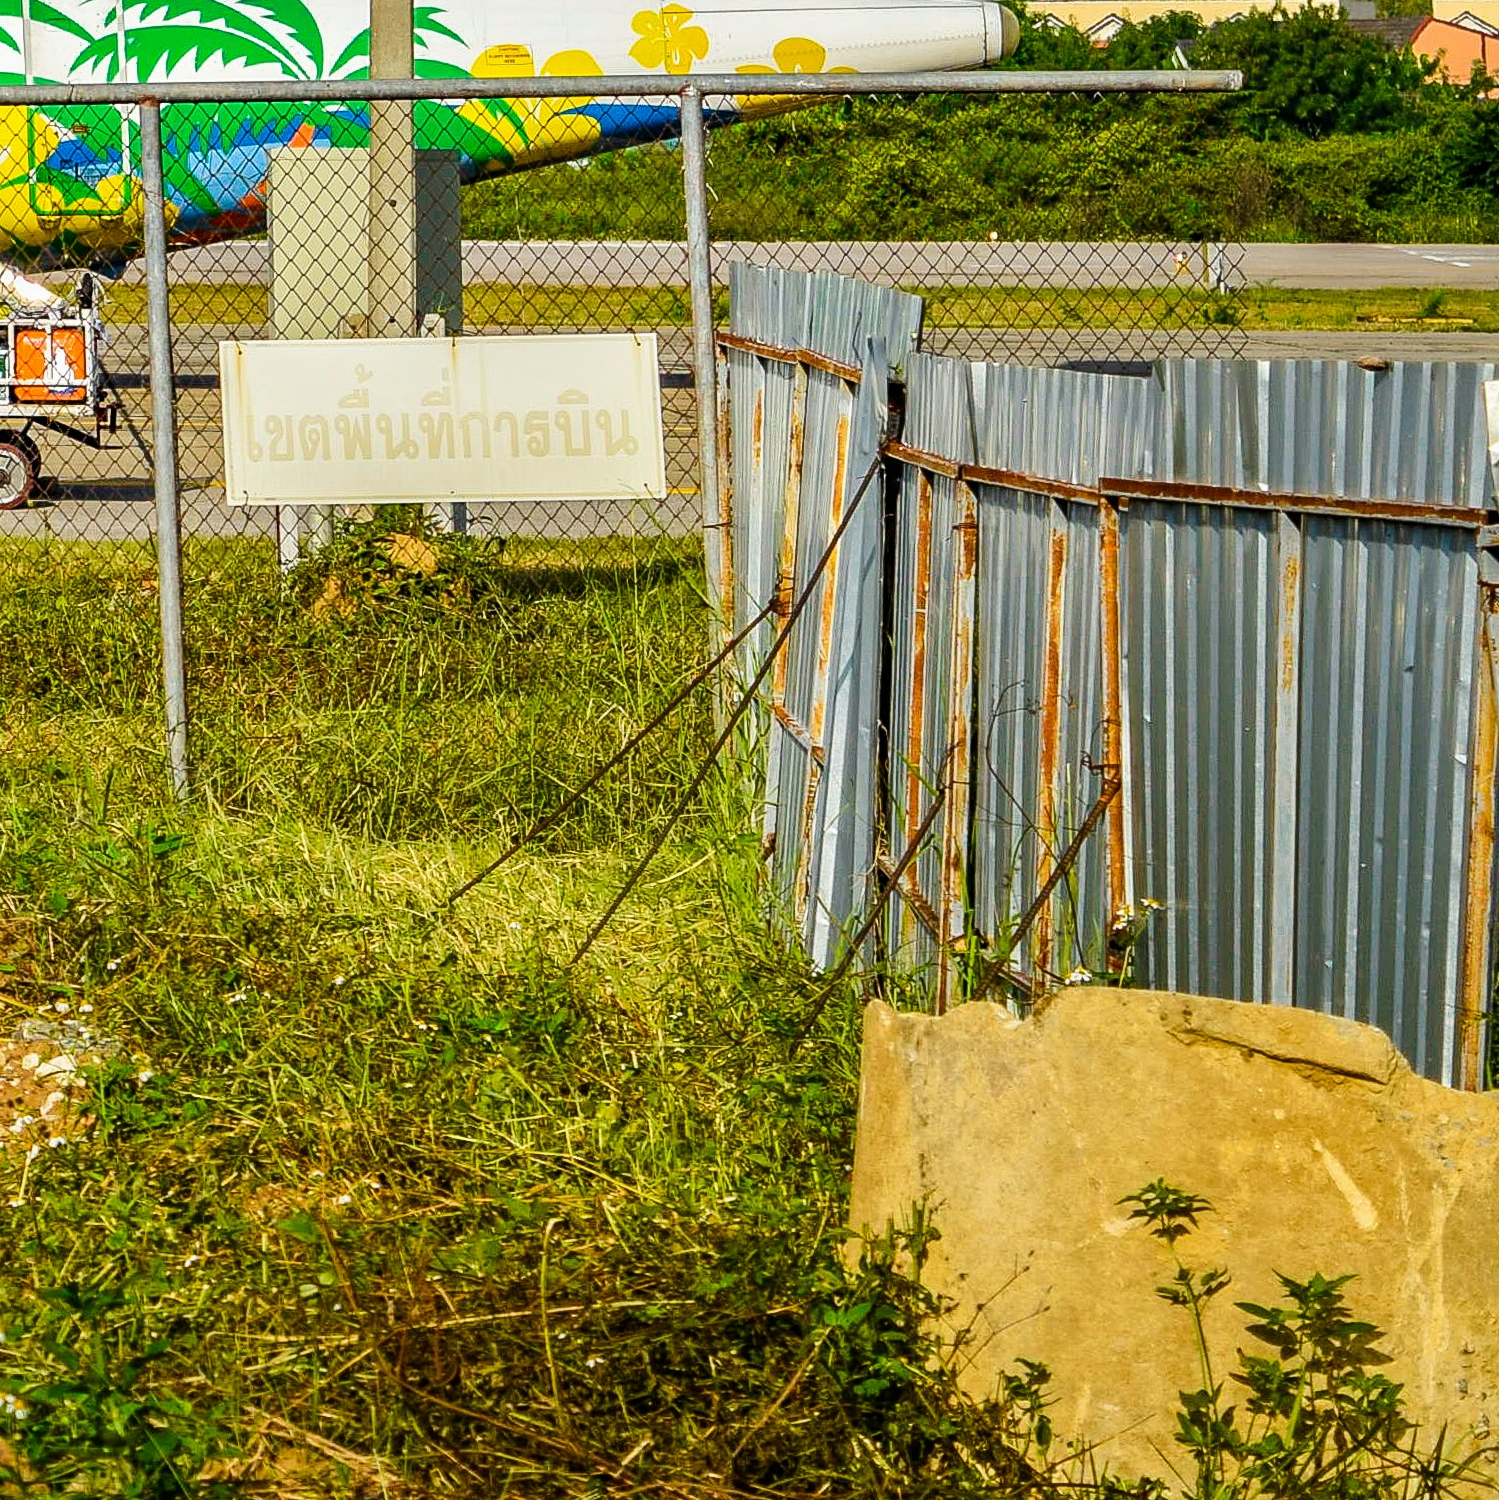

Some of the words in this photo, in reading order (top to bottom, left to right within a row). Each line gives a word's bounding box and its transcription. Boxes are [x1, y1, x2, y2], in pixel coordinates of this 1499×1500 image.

[245, 363, 639, 462] เขตพื้นที่การบิน
